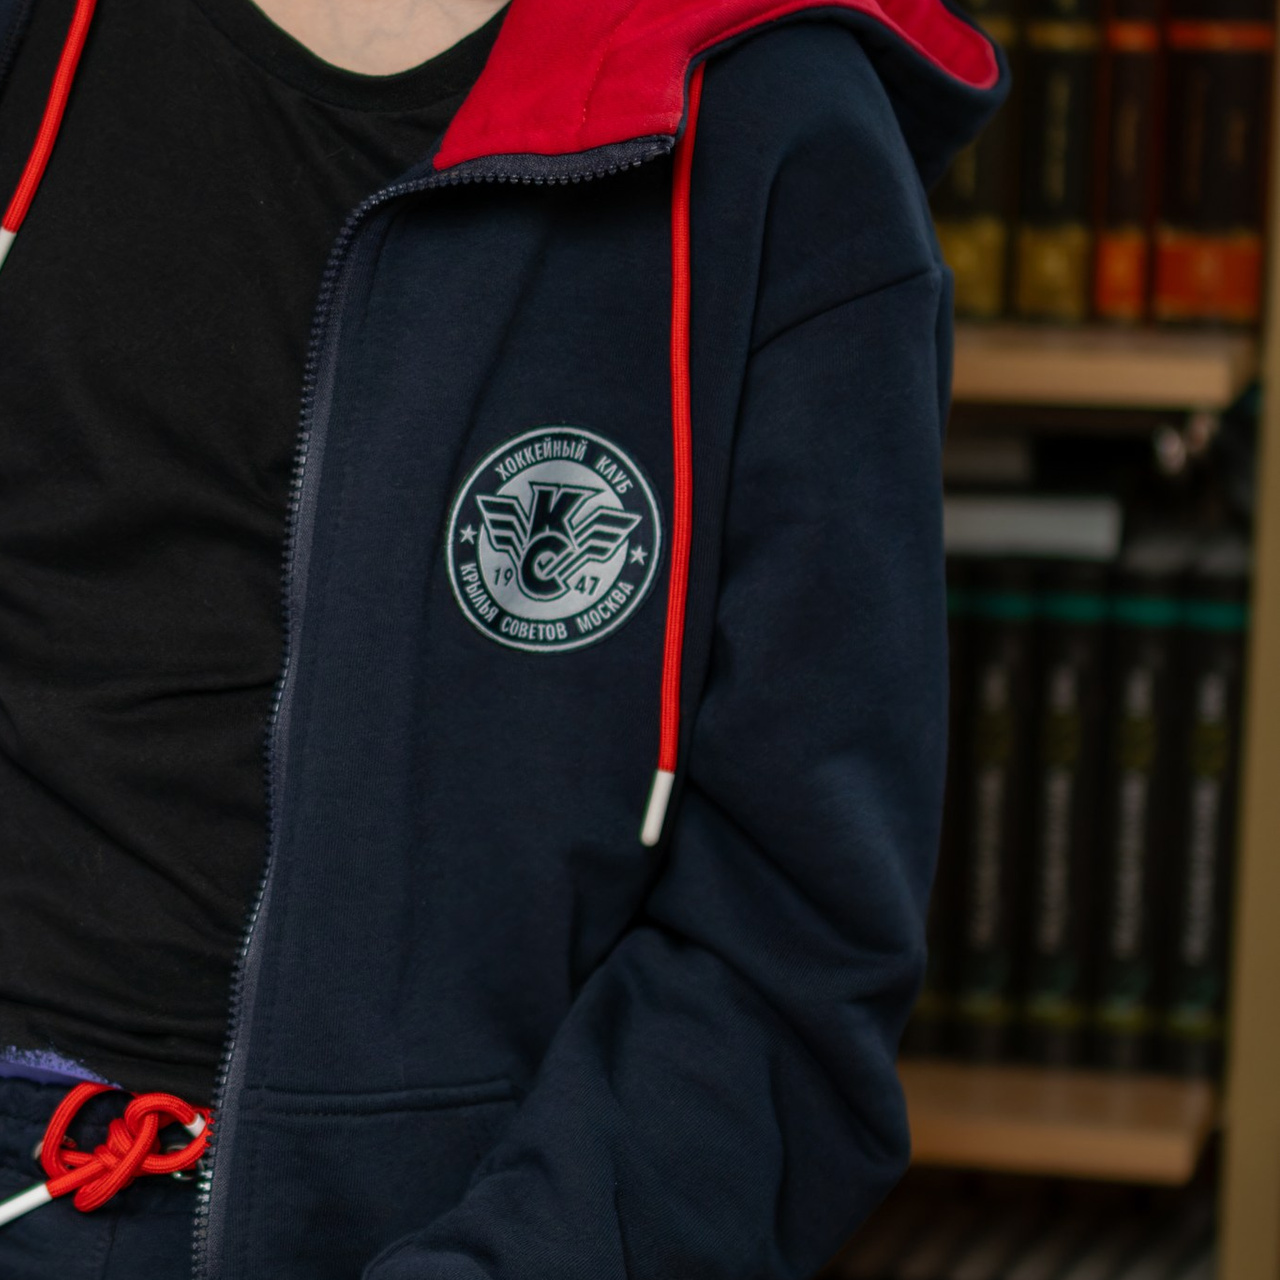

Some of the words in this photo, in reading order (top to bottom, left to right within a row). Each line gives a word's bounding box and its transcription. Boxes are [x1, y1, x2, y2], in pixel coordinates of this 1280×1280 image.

[496, 437, 588, 480] ХОККЕЙНЫЙ
[596, 456, 633, 494] КЛУБ
[460, 563, 498, 622] КРЫЛЬЯ
[500, 616, 568, 641] СОВЕТОВ
[577, 582, 634, 634] МОСКВА
[493, 567, 514, 587] 19
[574, 575, 601, 596] 47
